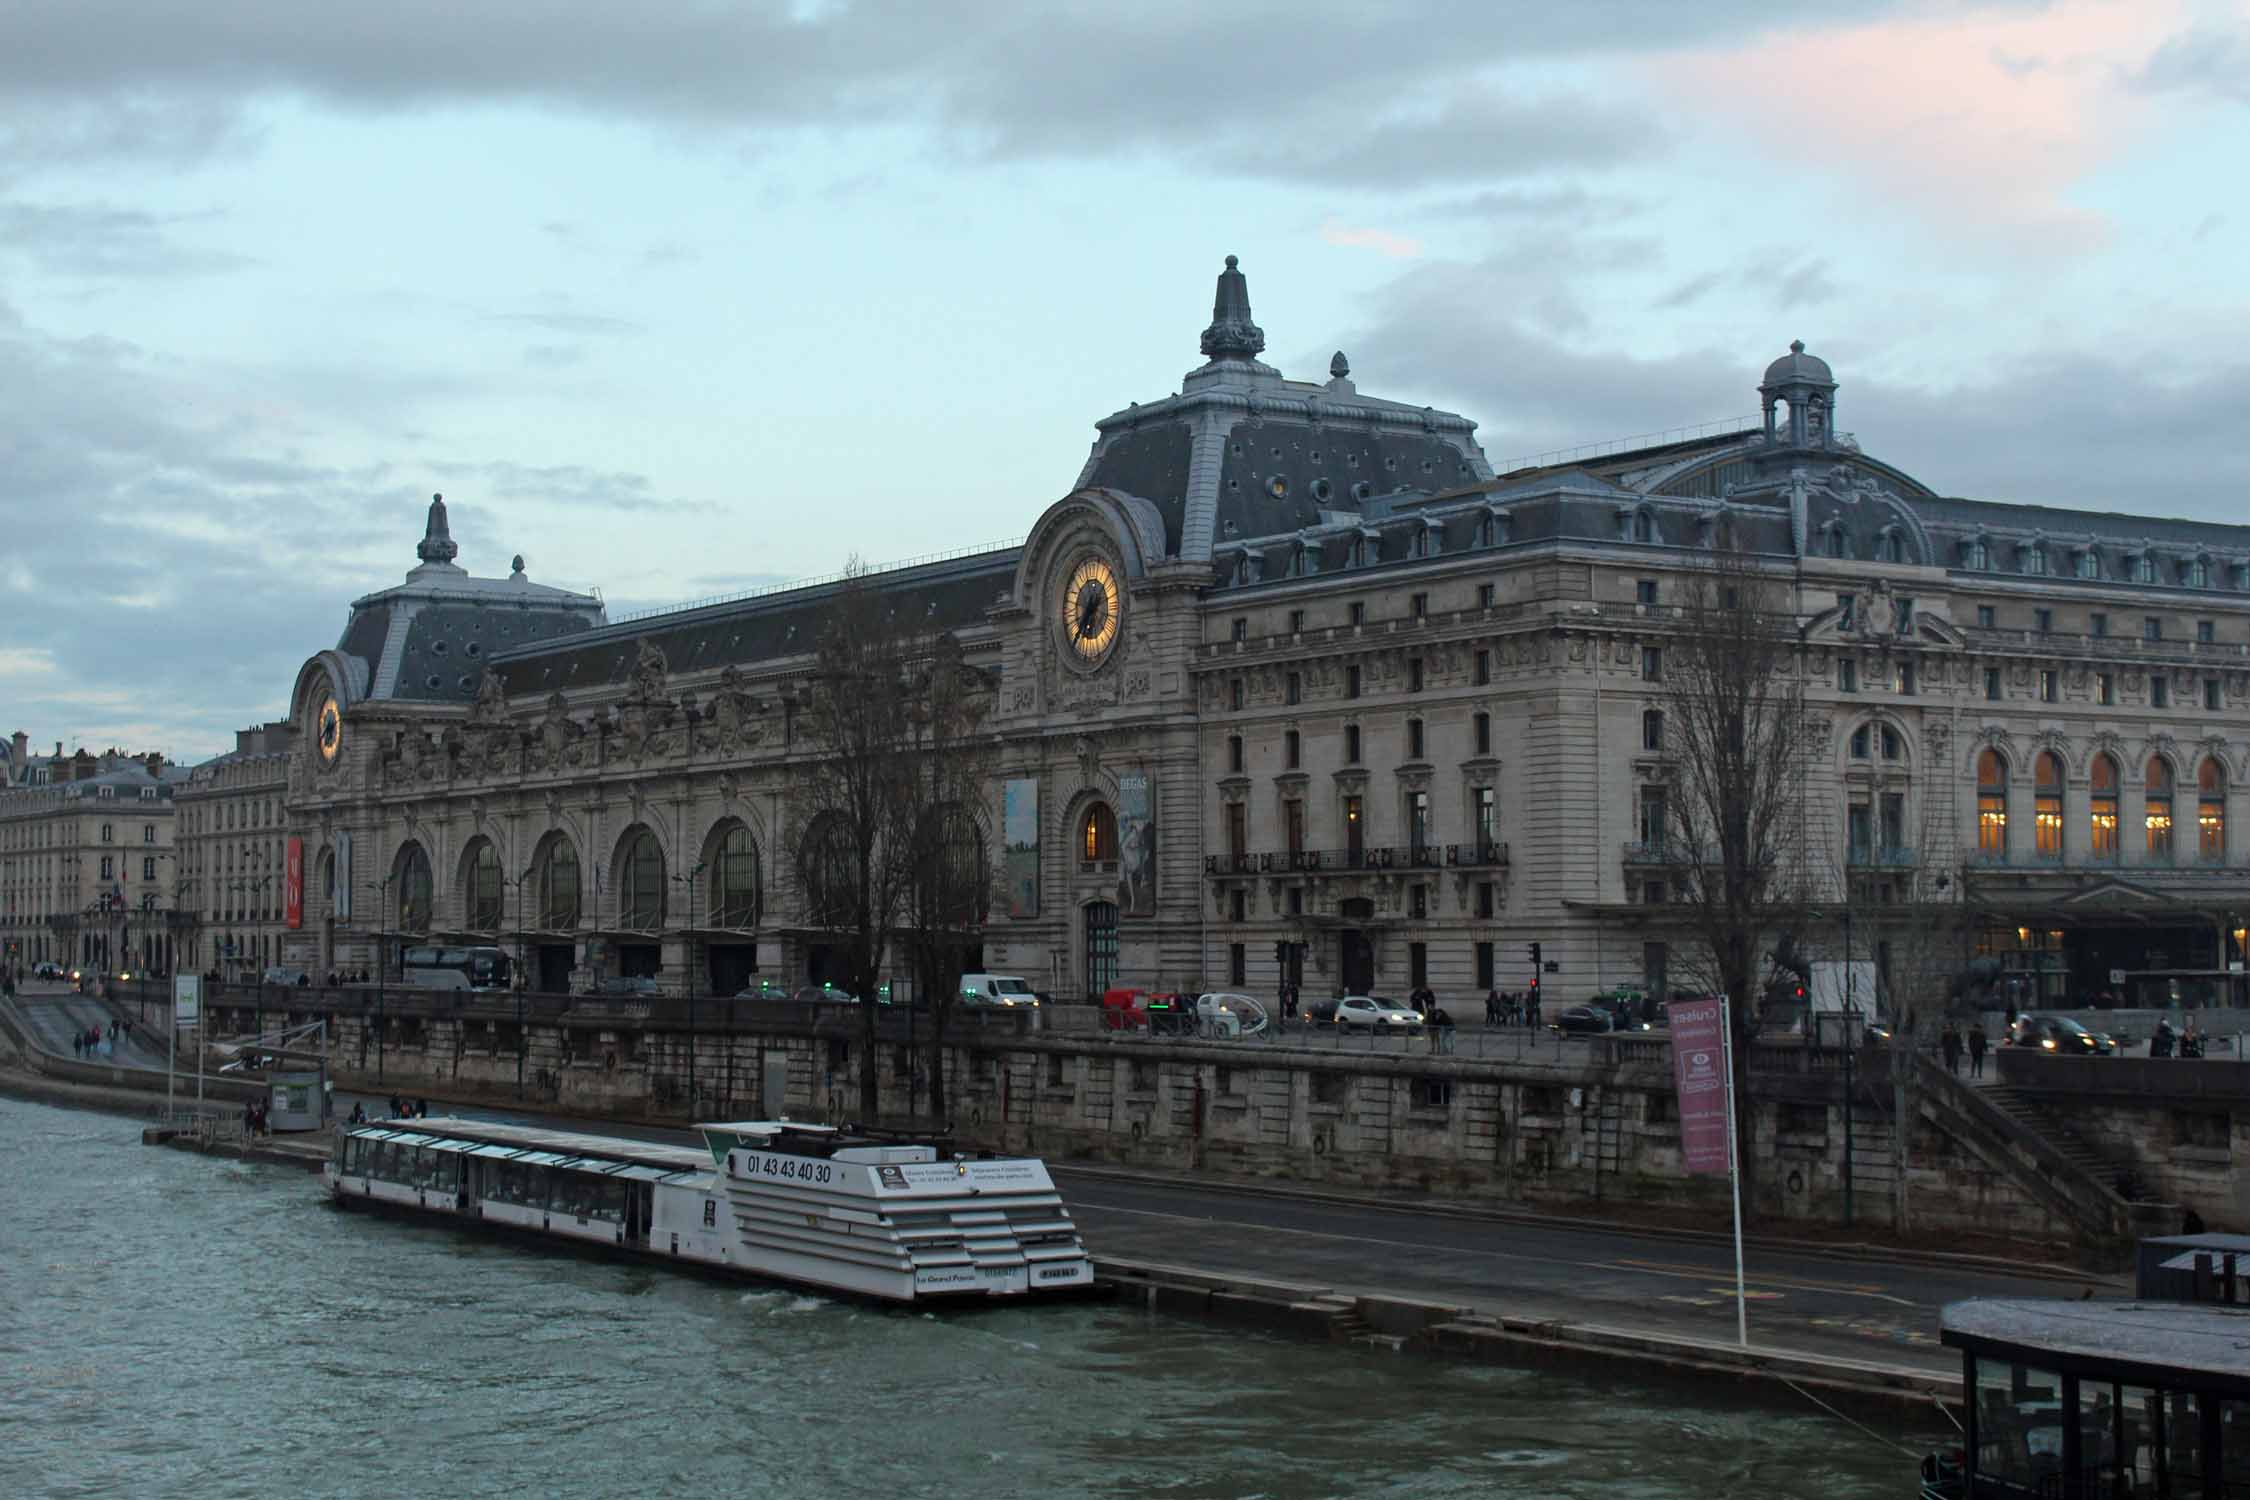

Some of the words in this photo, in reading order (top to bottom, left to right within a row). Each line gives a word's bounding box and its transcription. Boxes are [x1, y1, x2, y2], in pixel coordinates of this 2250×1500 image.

[1119, 776, 1147, 790] DEGAS
[748, 1155, 759, 1173] 01
[763, 1158, 778, 1176] 43
[781, 1160, 795, 1178] 43
[798, 1163, 813, 1181] 40
[816, 1164, 831, 1183] 30
